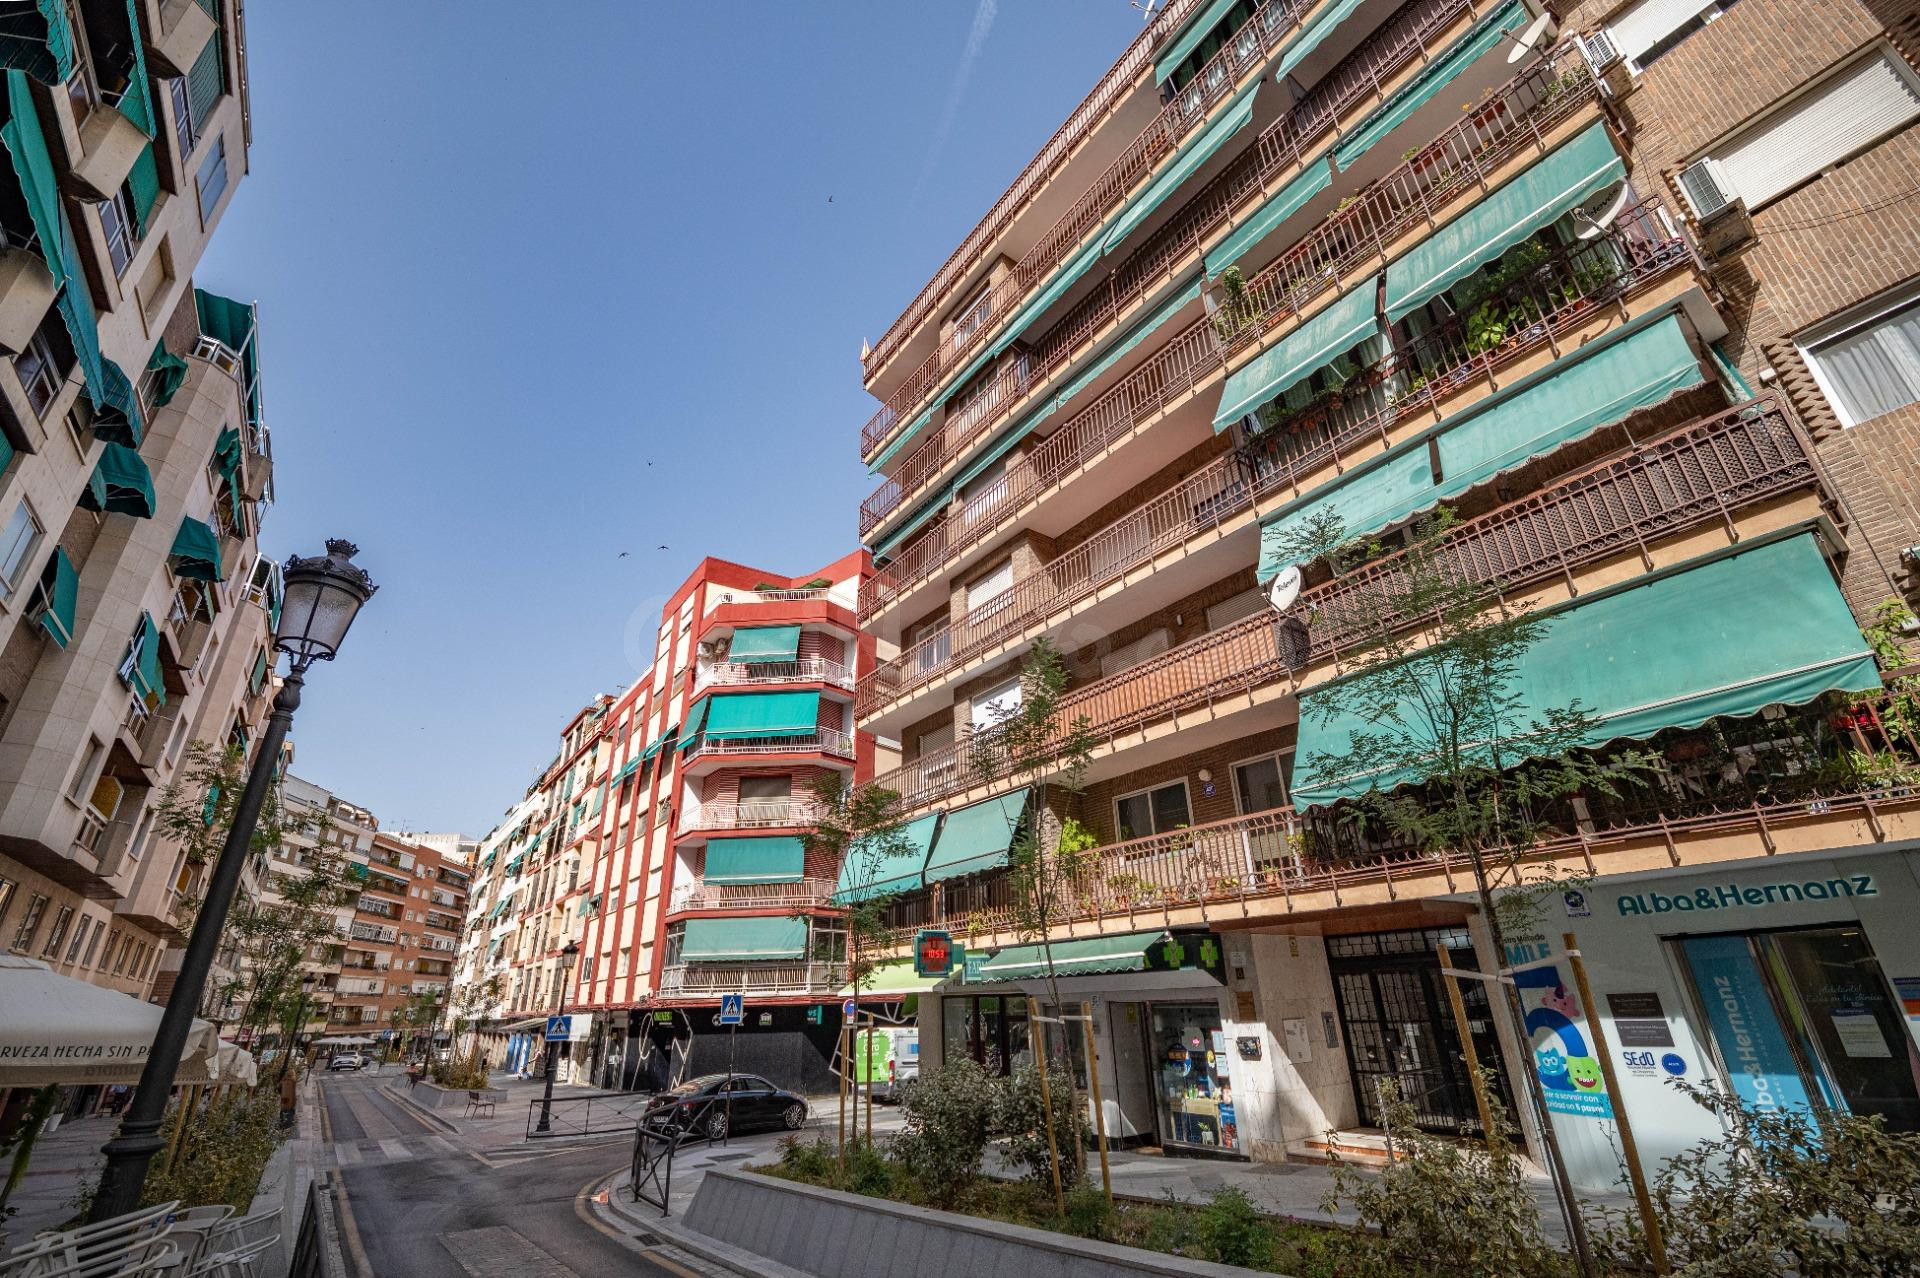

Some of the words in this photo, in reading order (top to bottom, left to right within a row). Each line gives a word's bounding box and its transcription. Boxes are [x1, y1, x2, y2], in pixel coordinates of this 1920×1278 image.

[1617, 876, 1878, 917] Alba&Hernanz
[0, 1045, 49, 1058] RVEZA
[53, 1045, 102, 1058] HECHA
[107, 1045, 131, 1057] SIN
[1714, 976, 1778, 1113] lba&Hernanz
